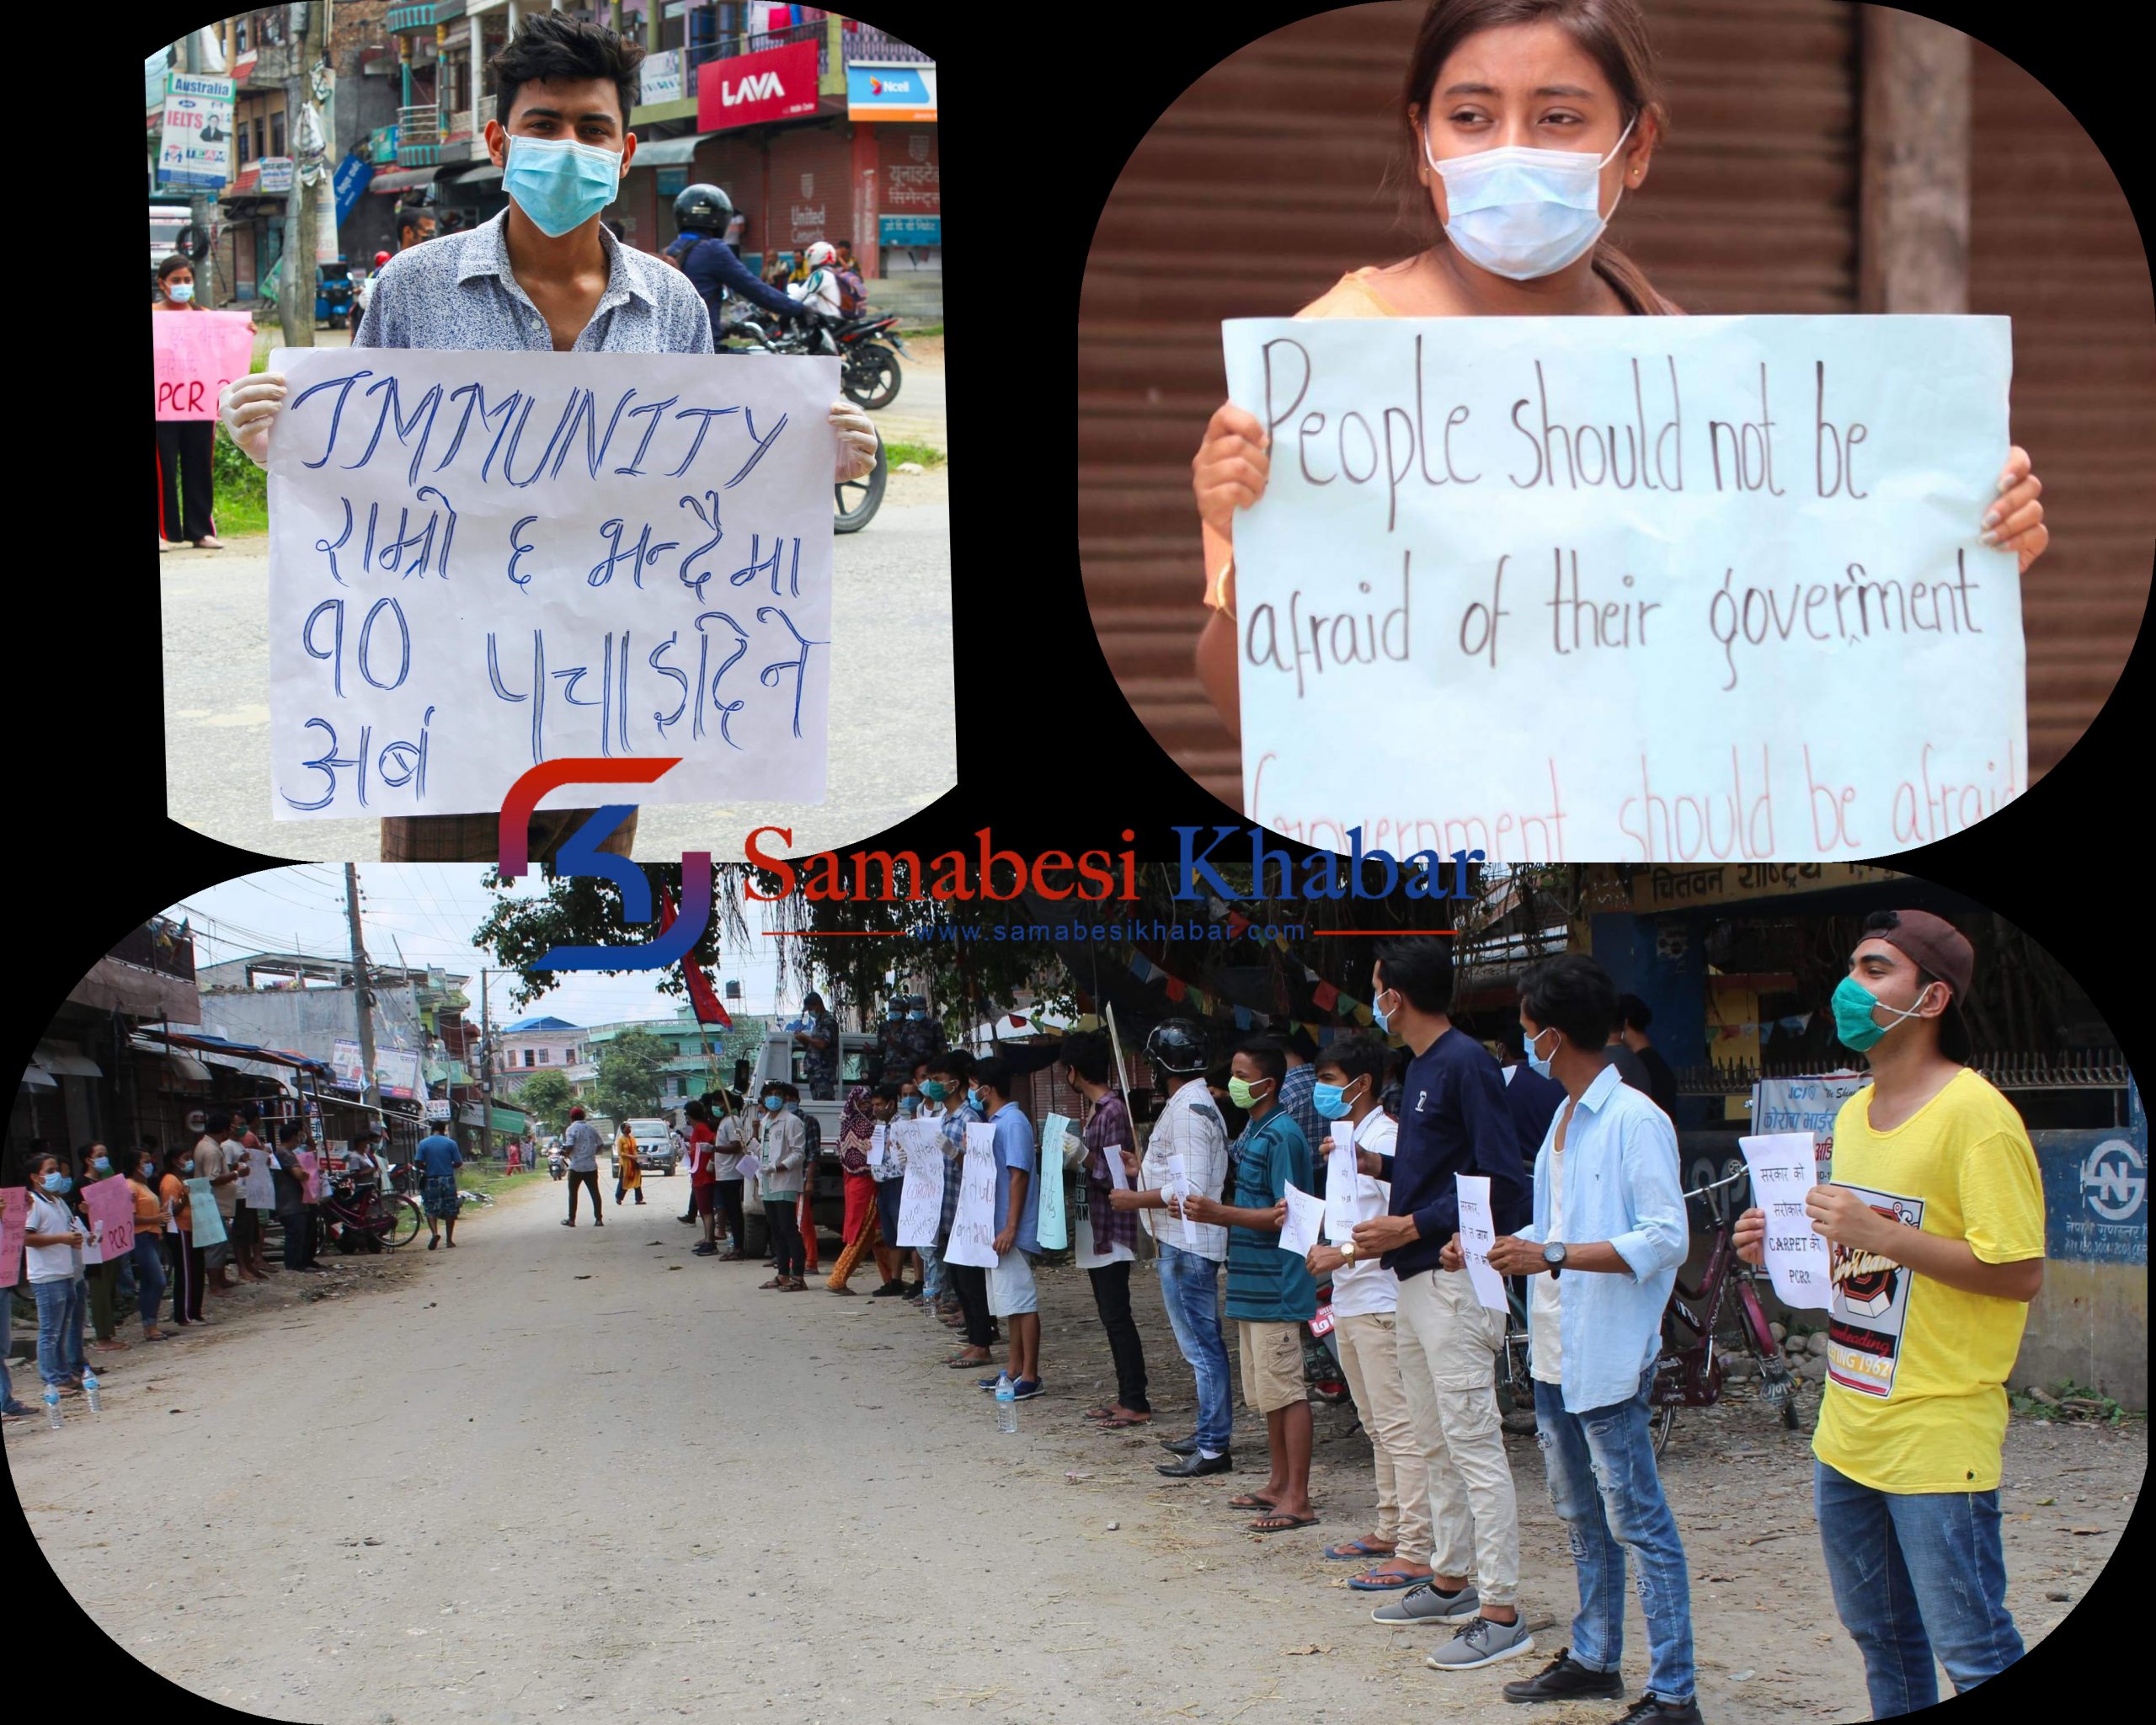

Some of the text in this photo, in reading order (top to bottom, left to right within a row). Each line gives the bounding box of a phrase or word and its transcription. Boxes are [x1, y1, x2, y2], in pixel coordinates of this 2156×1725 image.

[175, 77, 229, 96] Australia
[722, 72, 785, 107] LAVA
[883, 81, 910, 93] Ncell
[167, 109, 203, 129] IELTS
[158, 382, 204, 413] PCR
[291, 370, 788, 489] IMMUNITY
[1261, 334, 1869, 531] People should not be
[1246, 550, 1412, 698] afraid
[1460, 554, 1510, 668] of
[1546, 547, 1662, 656] their
[303, 597, 410, 698] १०
[1620, 743, 1774, 862] should
[1804, 744, 1861, 852] be
[1652, 866, 1724, 902] चितवन
[1760, 1167, 1788, 1183] सरकार
[1769, 1237, 1807, 1252] CARPET
[1858, 1354, 1890, 1377] 1962
